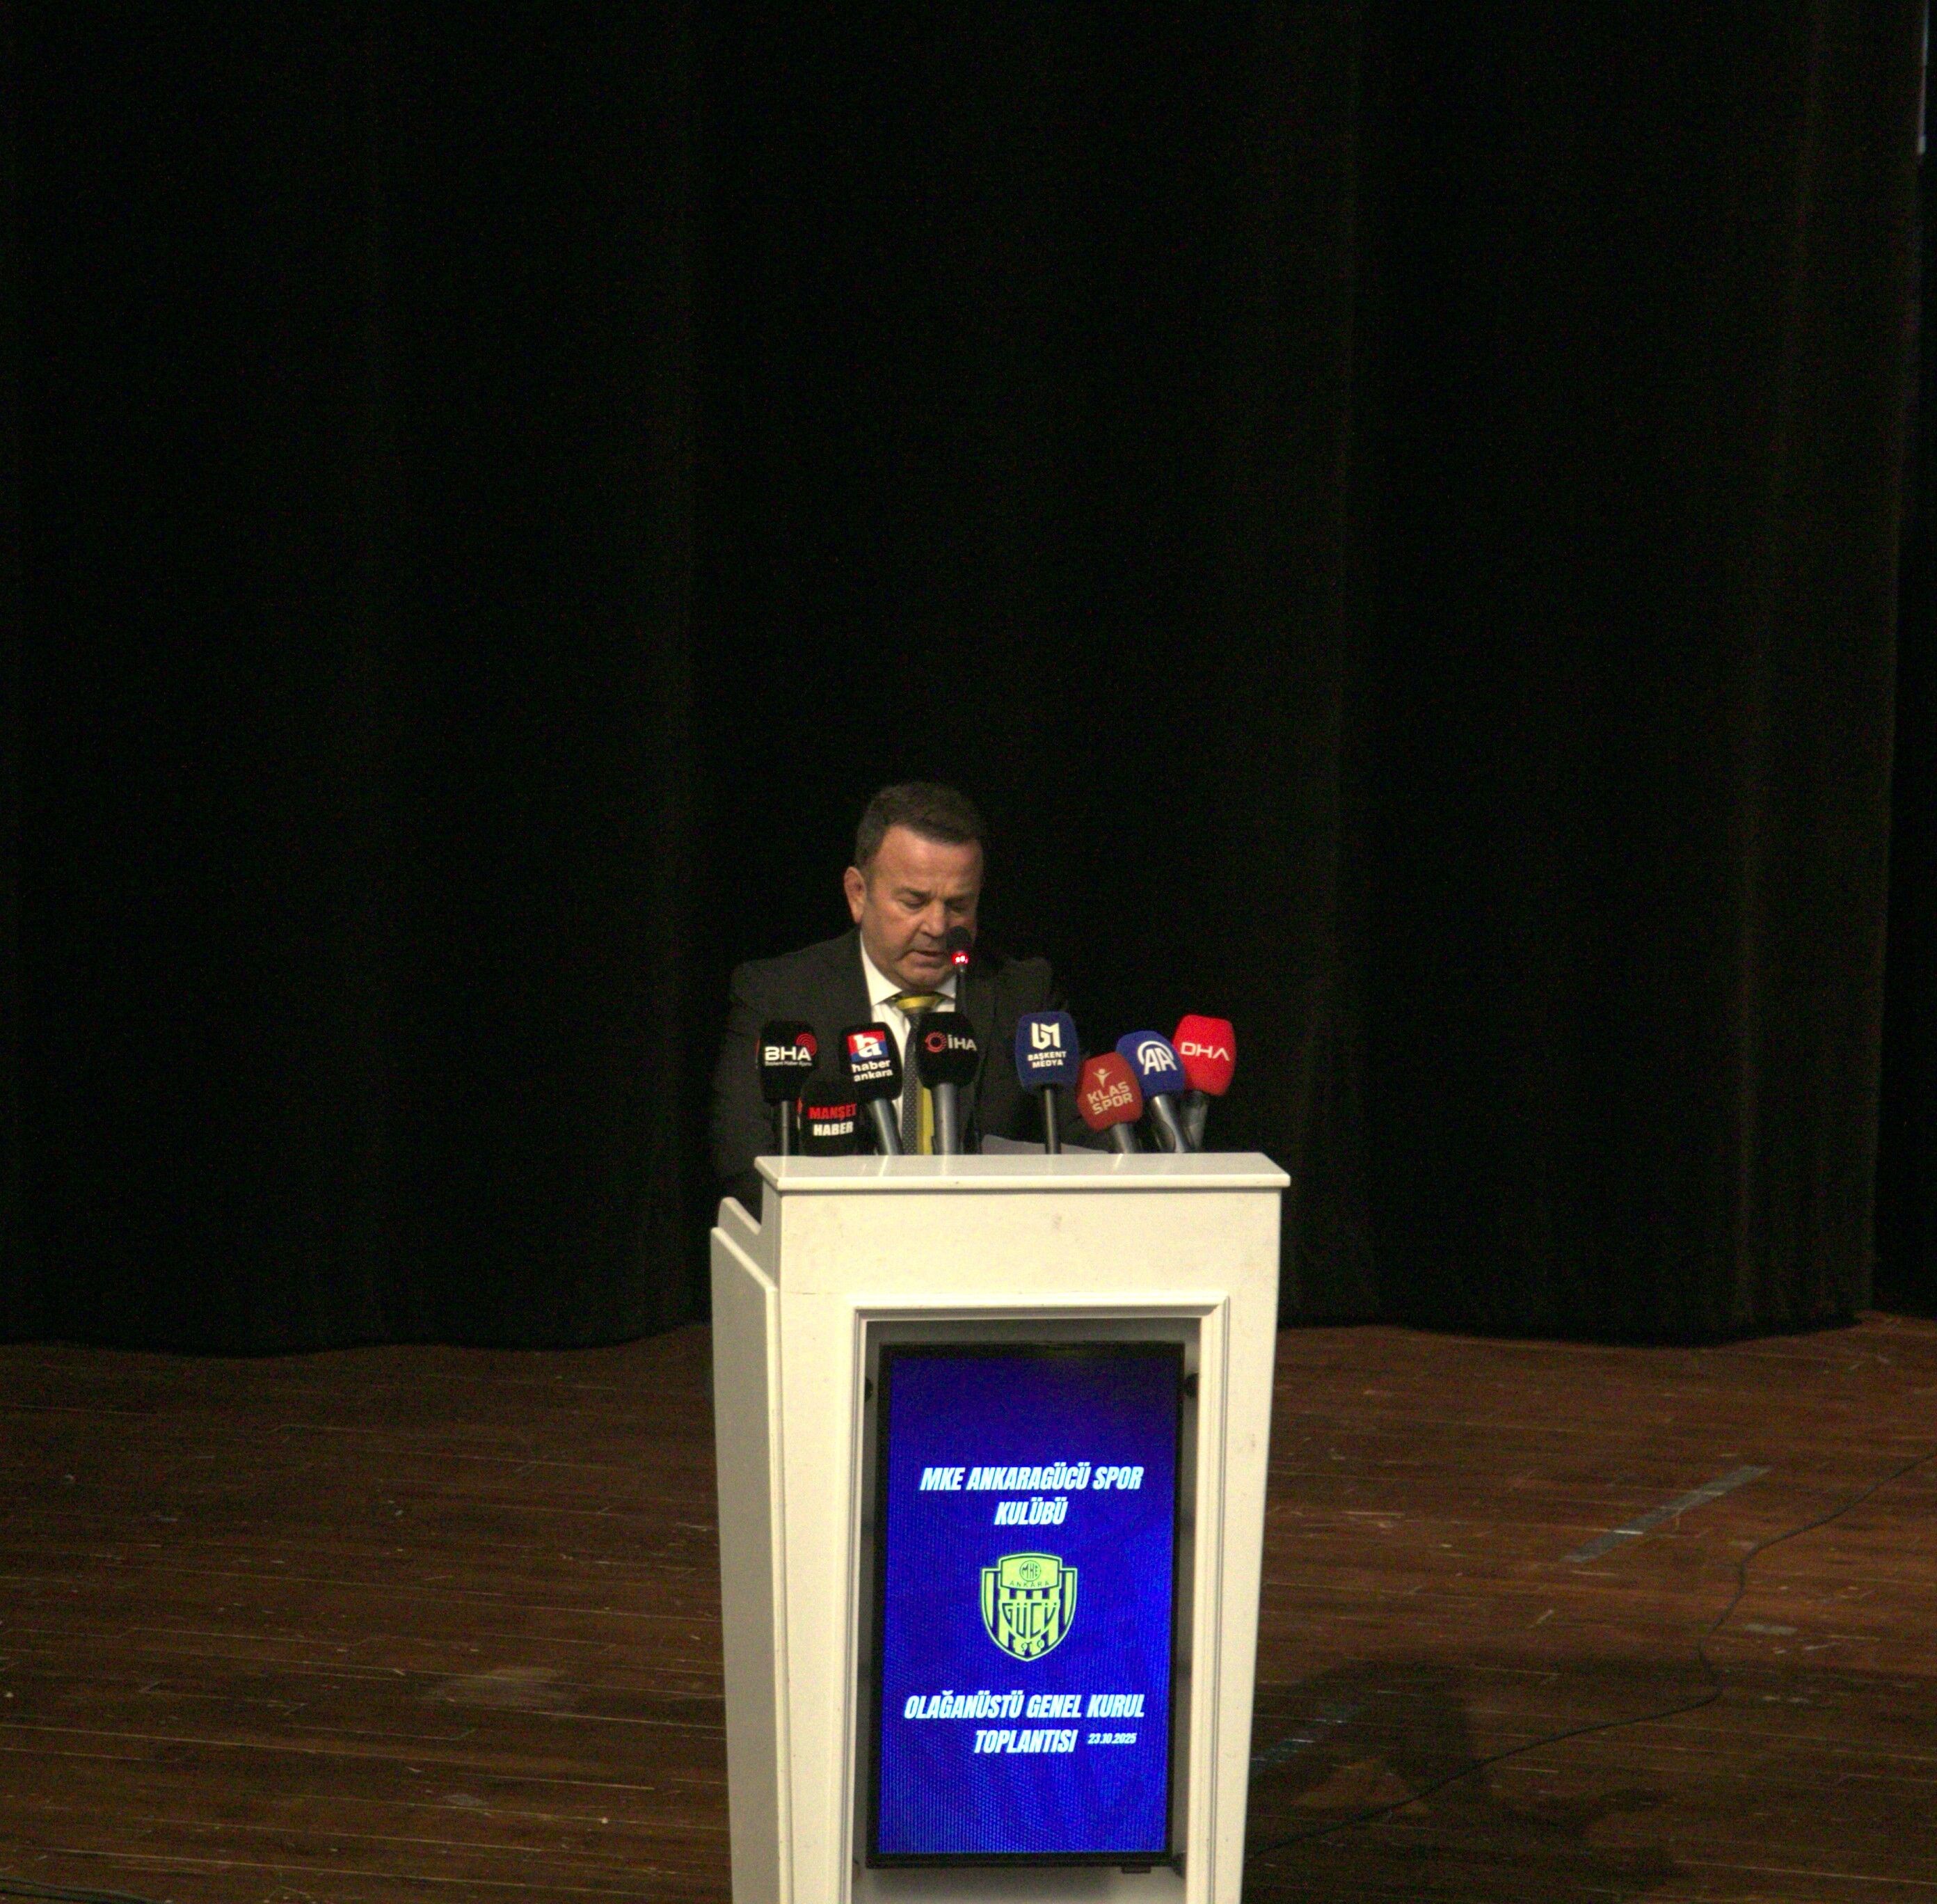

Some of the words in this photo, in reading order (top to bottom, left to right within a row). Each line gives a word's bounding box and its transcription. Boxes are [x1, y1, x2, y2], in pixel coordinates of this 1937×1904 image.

[948, 1034, 977, 1052] İHA
[1181, 1042, 1230, 1062] DHA
[765, 1046, 811, 1061] BHA
[1028, 1051, 1067, 1061] BAŞKENT
[1144, 1047, 1177, 1075] AA
[852, 1060, 891, 1073] haber
[1032, 1059, 1064, 1068] MEDYA
[854, 1070, 893, 1082] ankara
[1087, 1081, 1130, 1104] KLAS
[808, 1103, 857, 1121] MANŞET
[1092, 1093, 1133, 1115] SPOR
[813, 1121, 854, 1136] HABER
[920, 1468, 966, 1491] MKE
[966, 1462, 1092, 1491] ANKARAGÜCÜ
[1092, 1466, 1145, 1489] SPOR
[994, 1497, 1069, 1525] KULÜBÜ
[904, 1690, 1025, 1718] OLAĞANÜSTÜ
[1026, 1695, 1082, 1718] GENEL
[1087, 1694, 1145, 1717] KURUL
[974, 1729, 1078, 1754] TOPLANTISI
[1087, 1732, 1138, 1745] 23.10.2025
